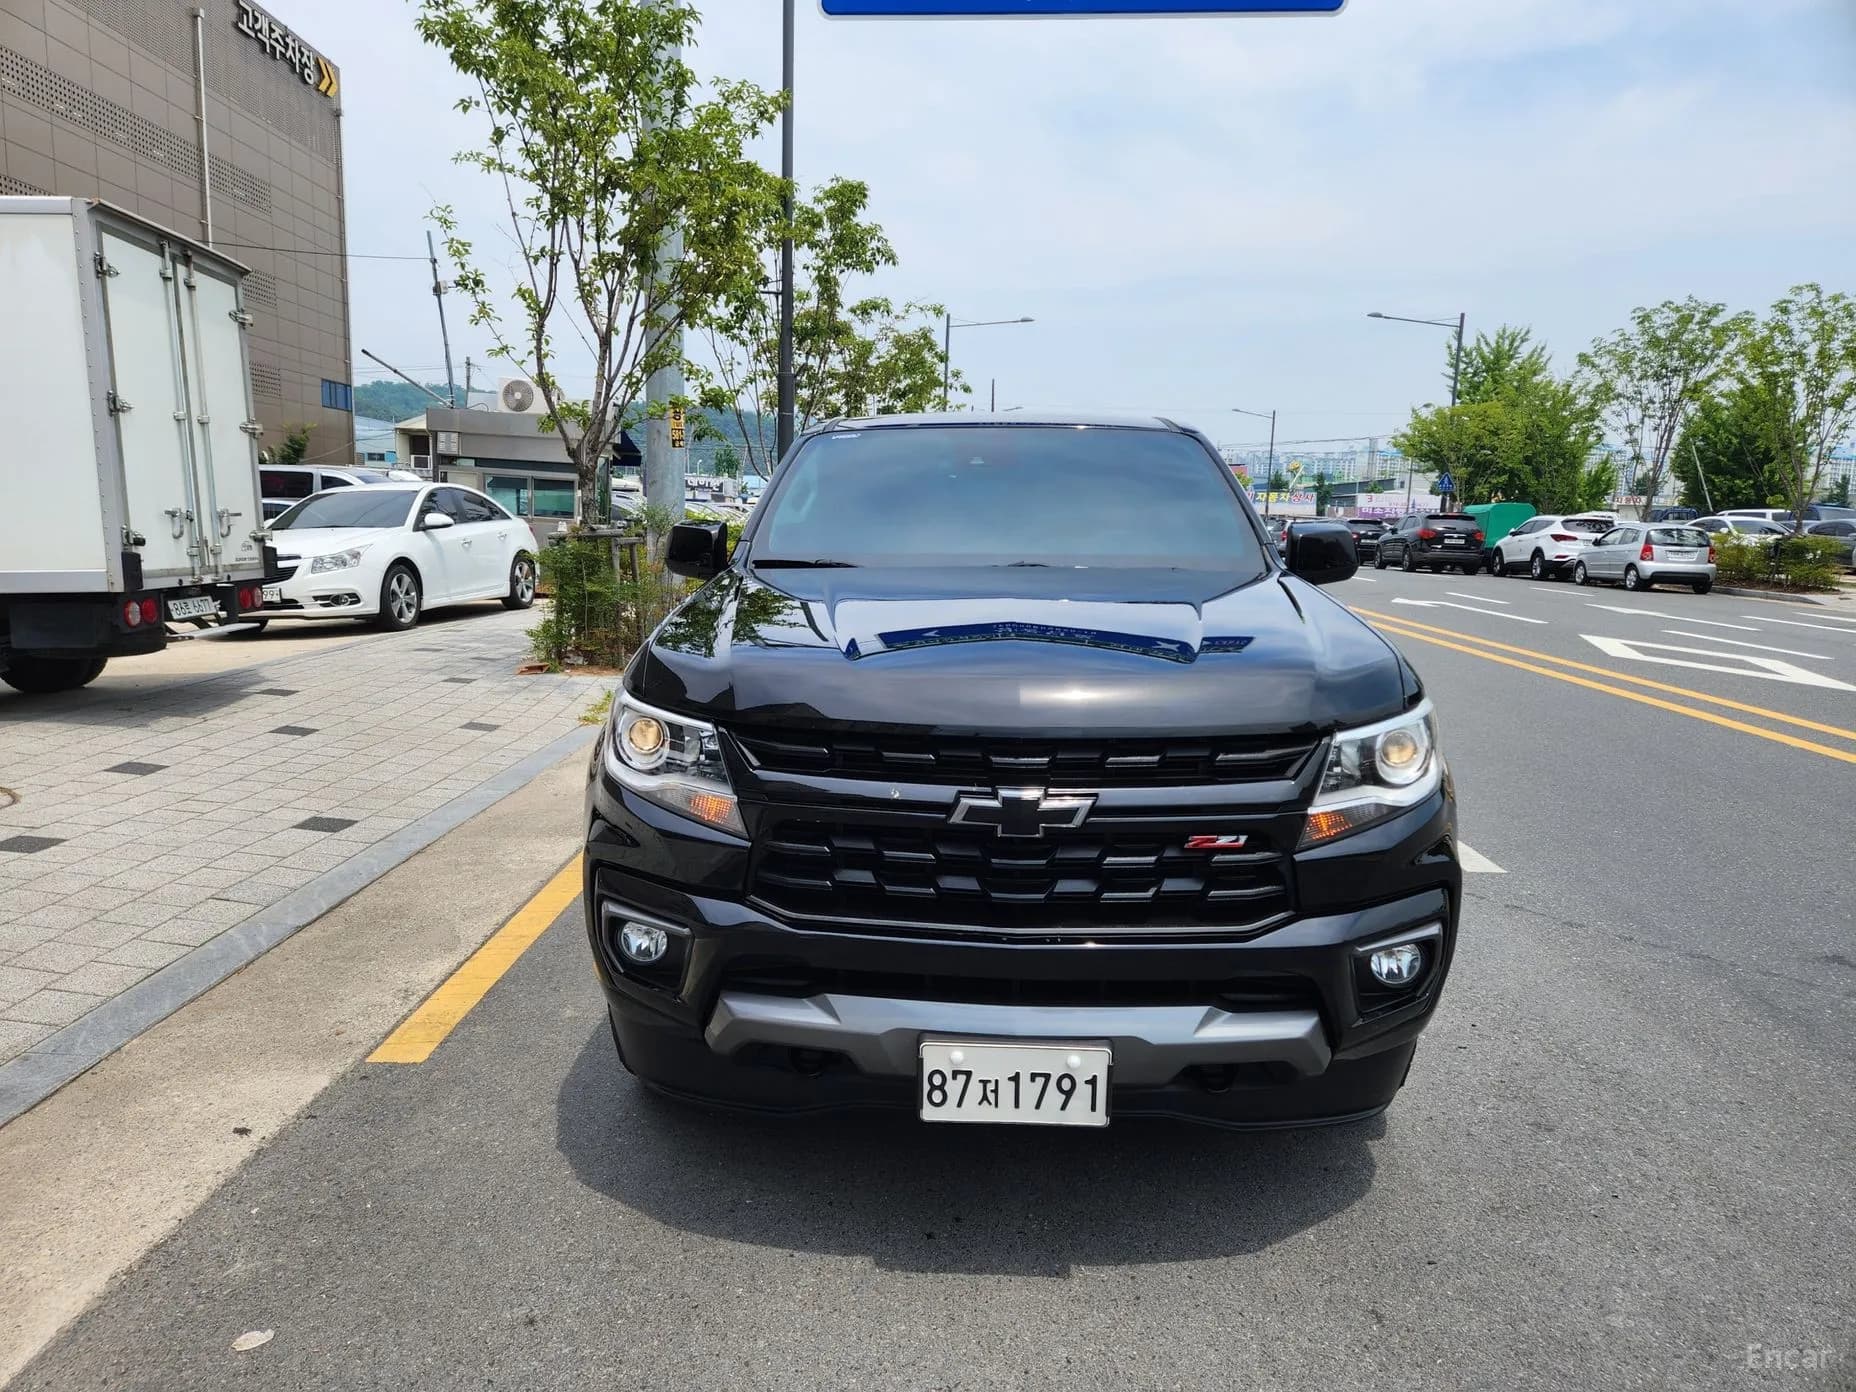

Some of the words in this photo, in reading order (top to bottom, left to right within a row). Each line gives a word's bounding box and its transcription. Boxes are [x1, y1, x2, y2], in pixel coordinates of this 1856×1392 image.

[238, 0, 315, 85] 고객주차장
[1184, 835, 1248, 848] Z71
[926, 1069, 1099, 1113] 87저1791
